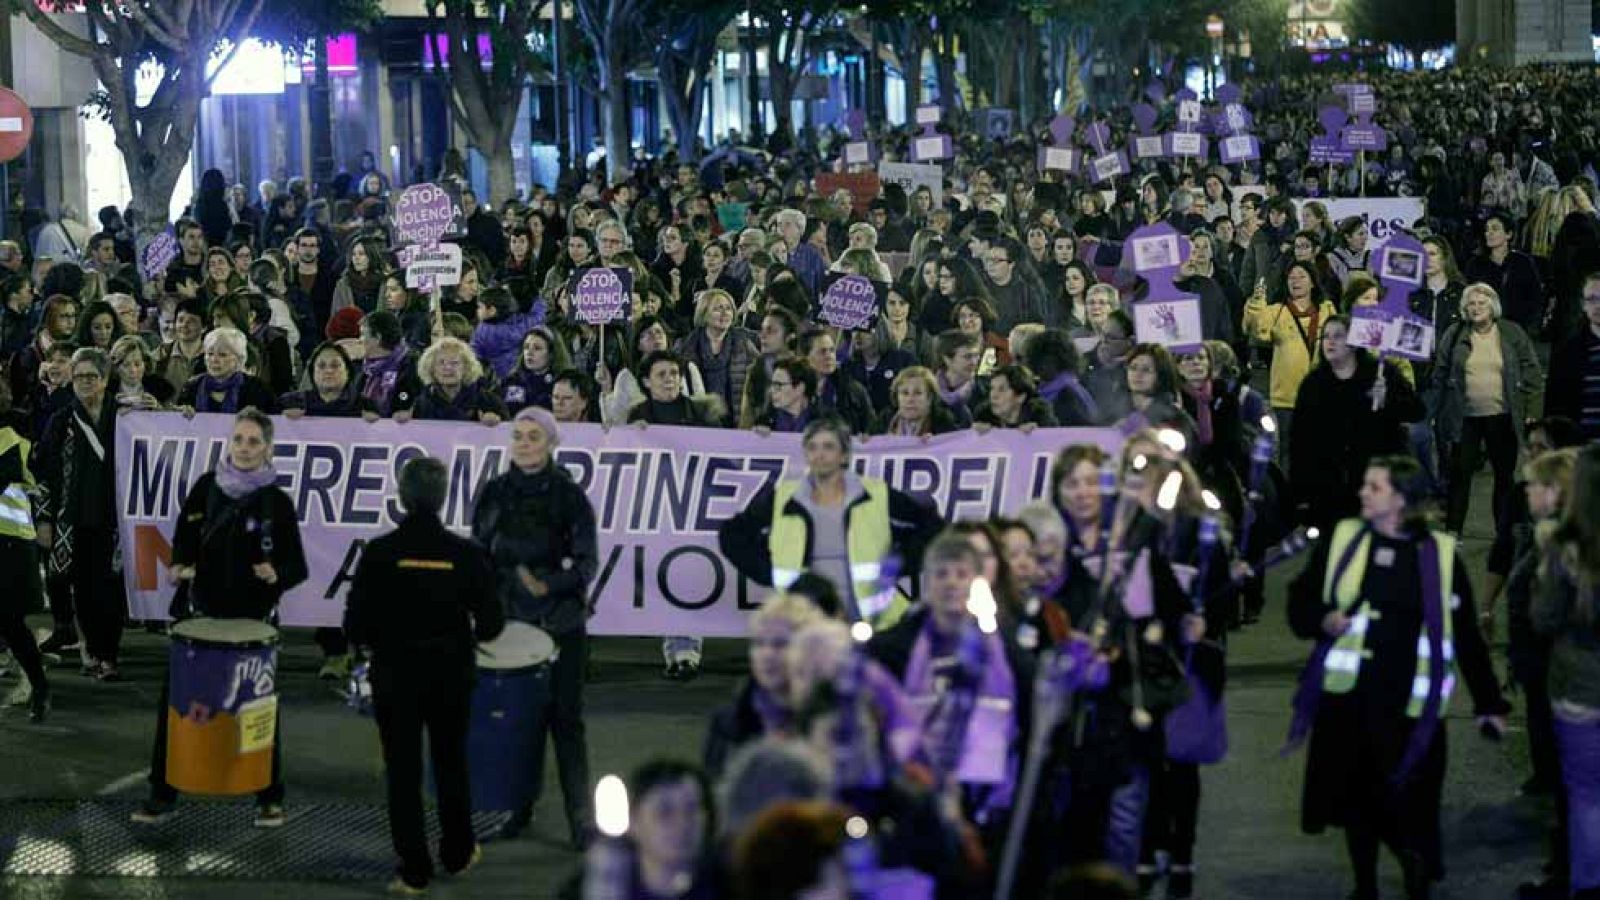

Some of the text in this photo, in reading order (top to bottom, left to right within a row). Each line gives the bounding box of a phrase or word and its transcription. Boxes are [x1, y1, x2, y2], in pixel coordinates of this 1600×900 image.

[401, 187, 441, 207] STOP
[390, 204, 462, 227] VIOLENCIA
[398, 221, 458, 242] machista
[582, 273, 618, 288] STOP
[834, 280, 874, 297] STOP
[570, 291, 630, 306] VIOLENCIA
[818, 293, 878, 317] VIOLENCIA
[575, 307, 625, 321] machista
[125, 436, 427, 526] MUERES
[443, 446, 788, 533] MRTINEZ
